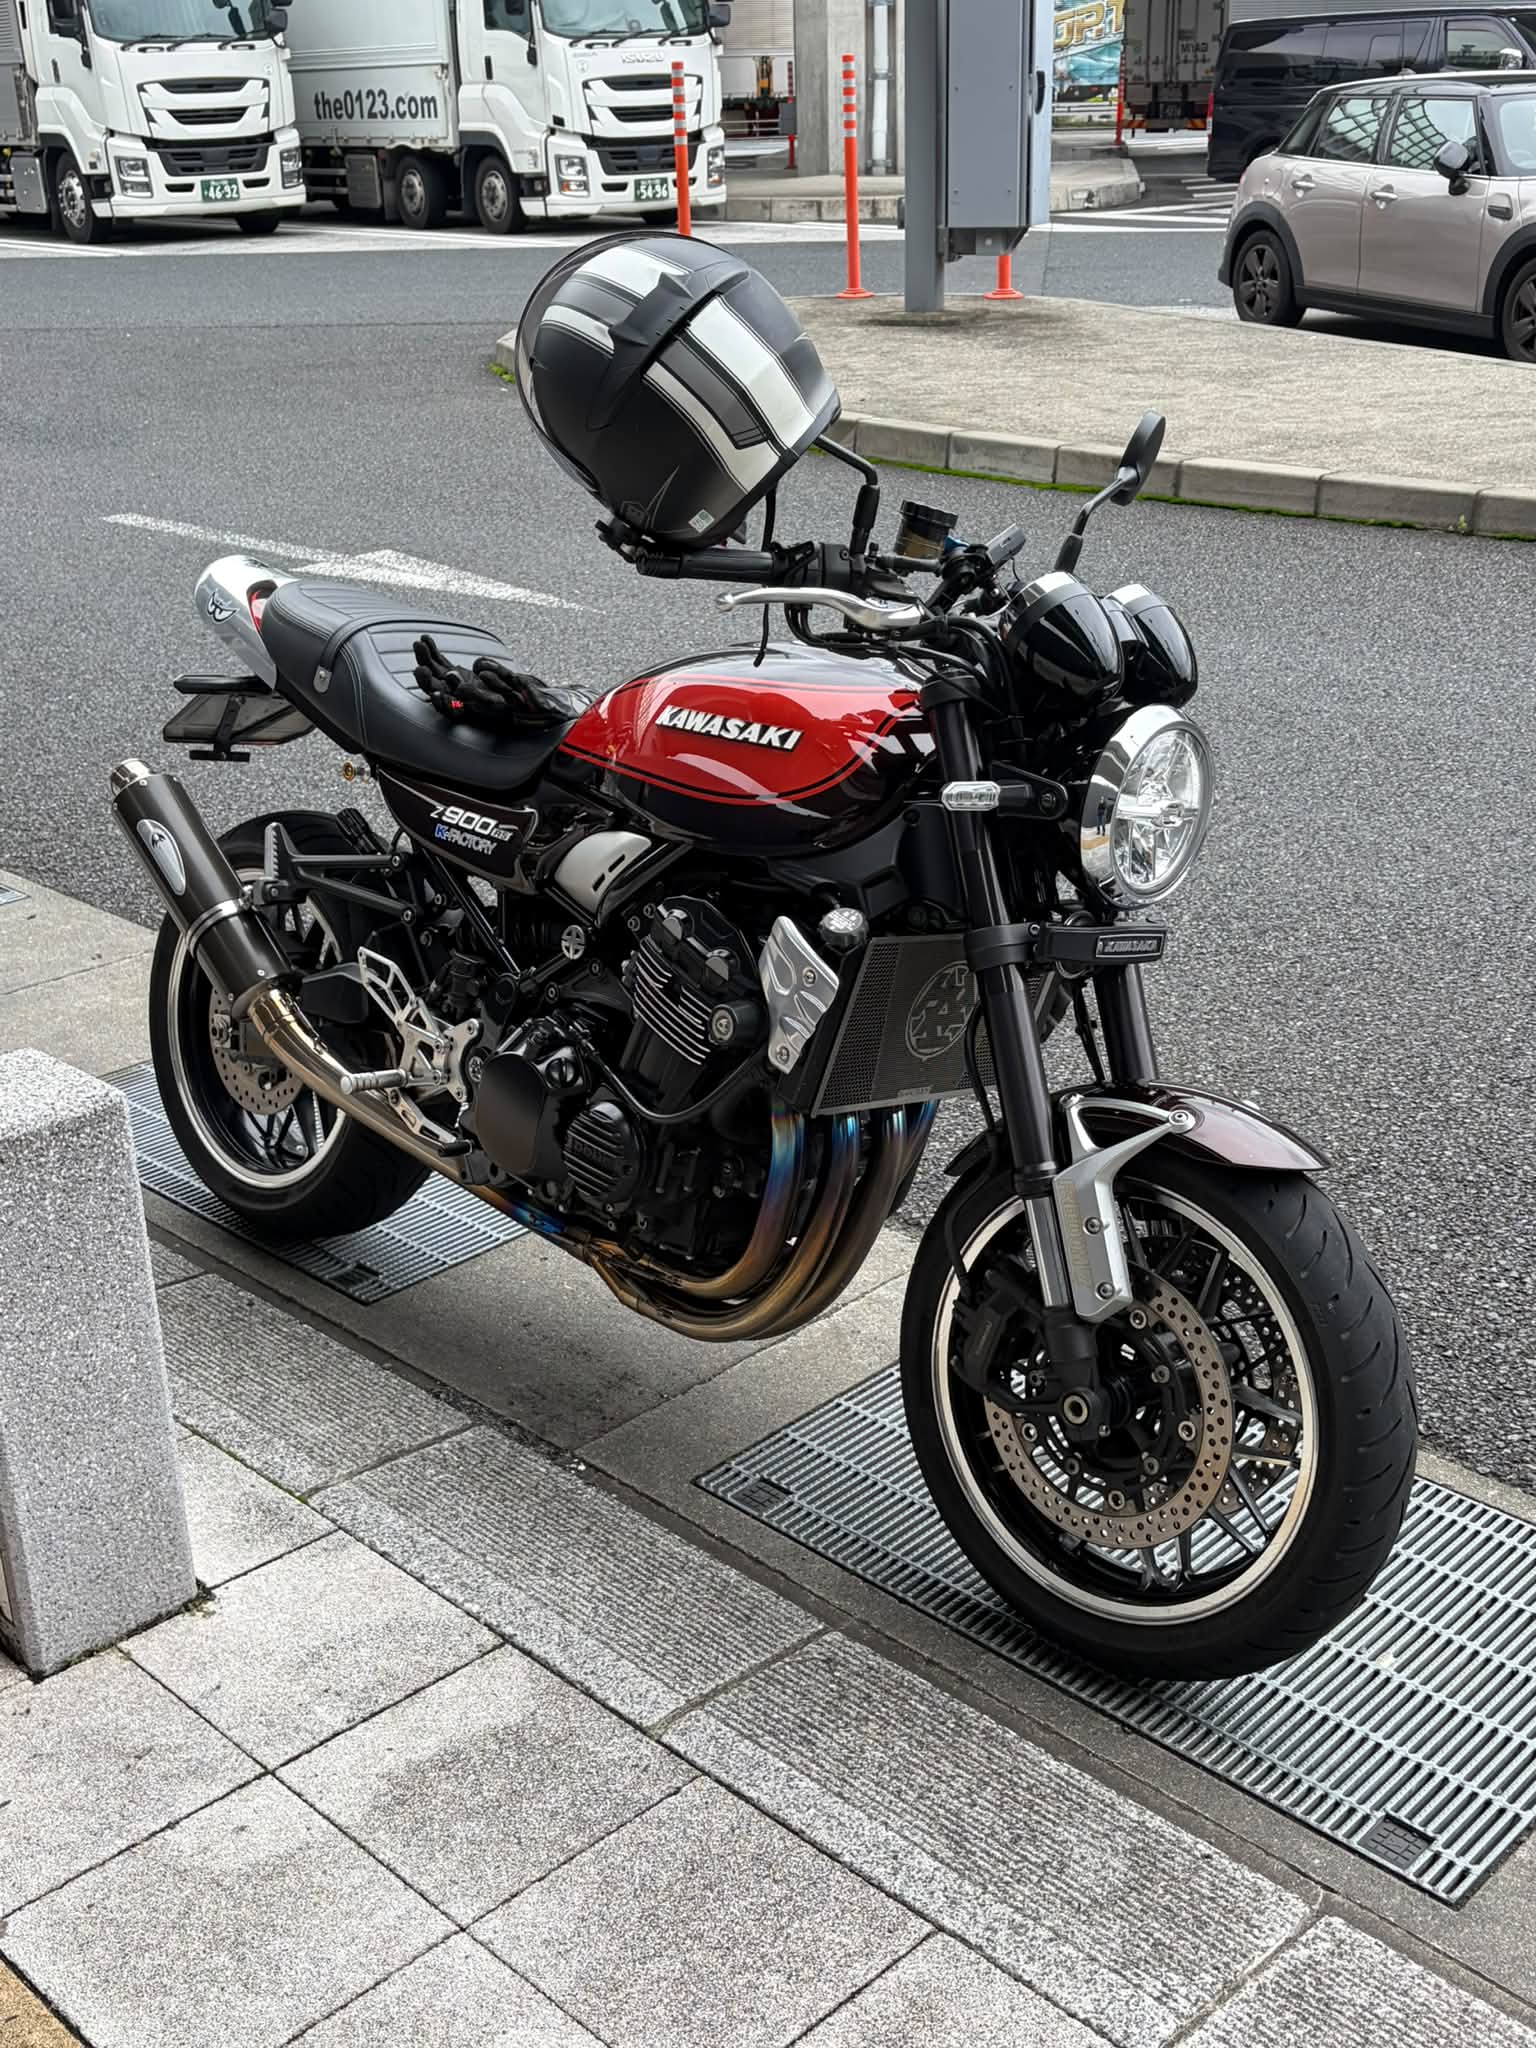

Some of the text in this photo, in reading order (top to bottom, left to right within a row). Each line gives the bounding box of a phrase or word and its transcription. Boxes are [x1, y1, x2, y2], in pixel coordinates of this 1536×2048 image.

[313, 88, 438, 120] the0123.com
[208, 184, 239, 200] 46-92
[640, 183, 668, 199] 54-96
[655, 705, 804, 750] KAWASAKI
